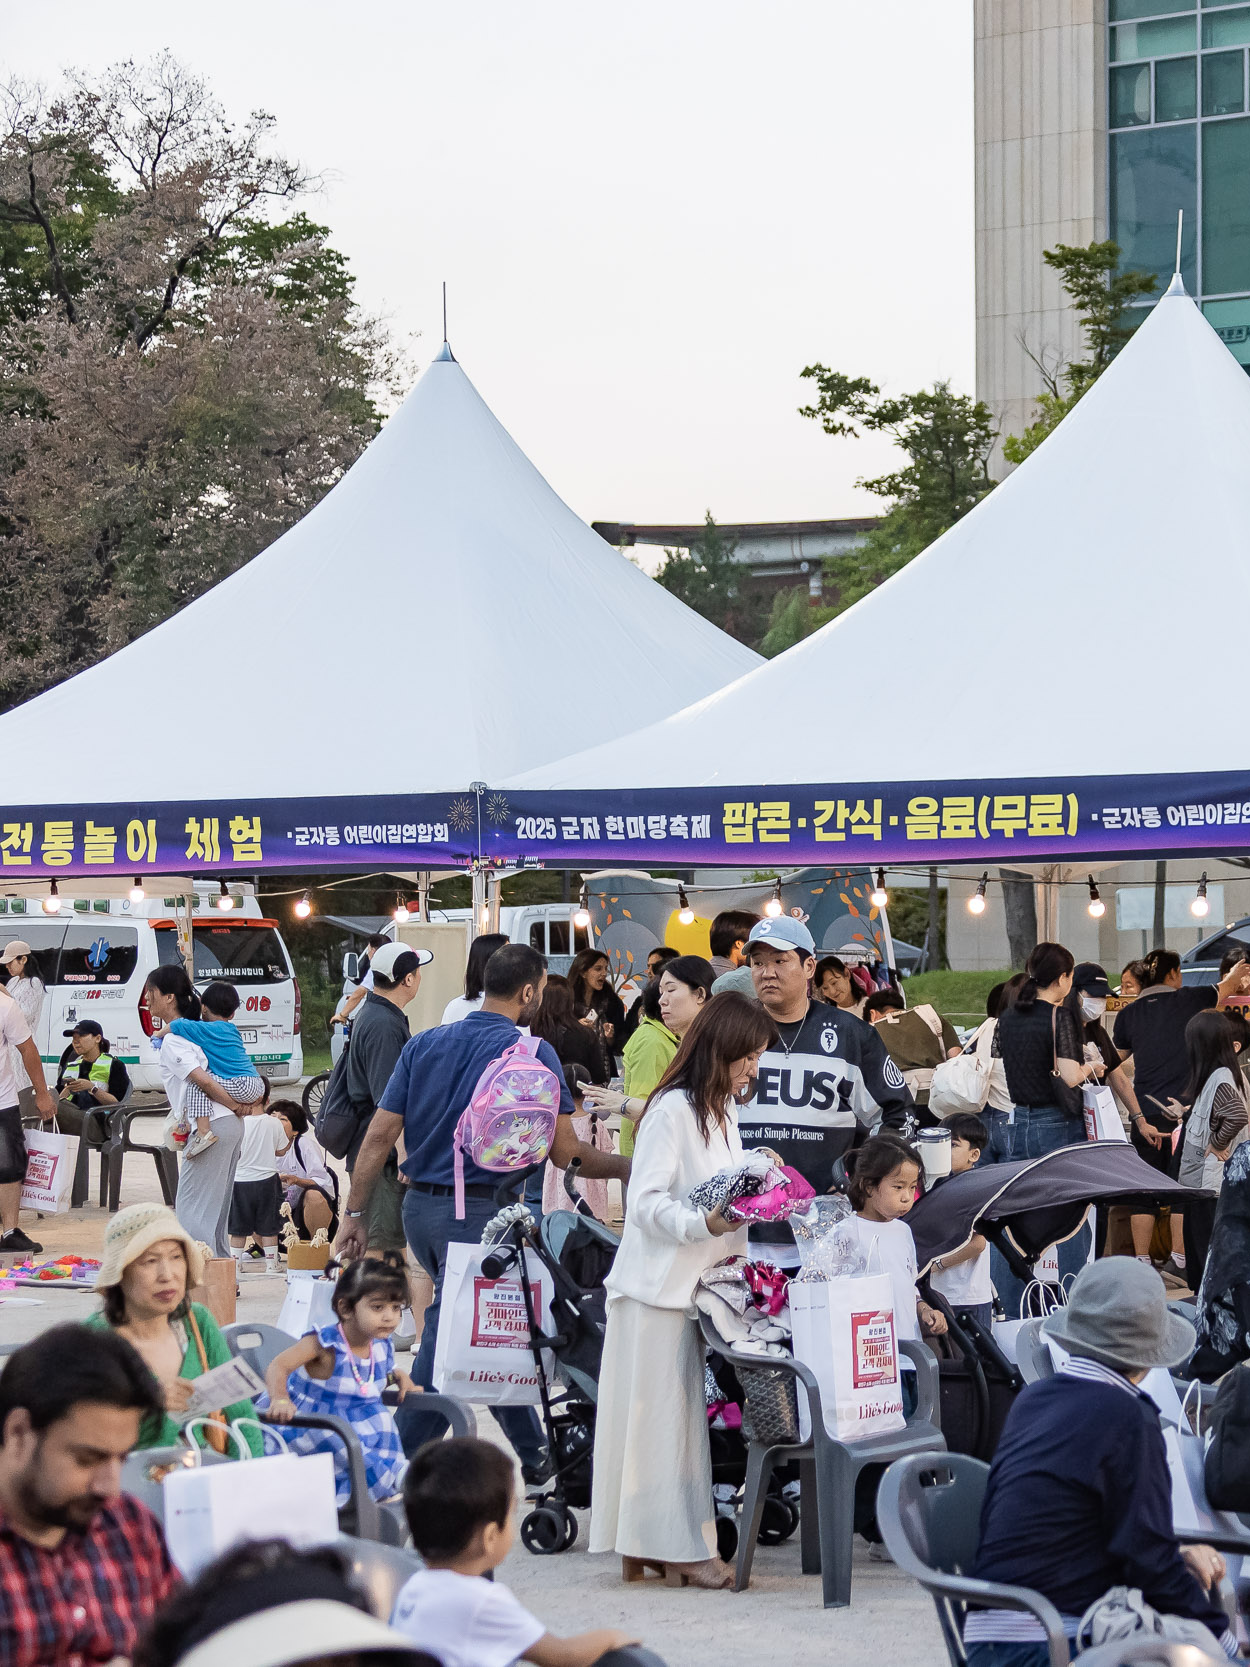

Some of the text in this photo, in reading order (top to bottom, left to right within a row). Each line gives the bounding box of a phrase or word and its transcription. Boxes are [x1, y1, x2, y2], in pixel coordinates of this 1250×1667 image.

[343, 823, 449, 845] 어린이집연합회
[515, 815, 711, 840] 2025 군자 한마당축제
[0, 815, 263, 866] 전통놀이 체험
[759, 919, 774, 935] S
[754, 1067, 837, 1111] EUS
[764, 1127, 790, 1141] Simple
[792, 1128, 824, 1141] Pleasures
[469, 1370, 505, 1383] Life's
